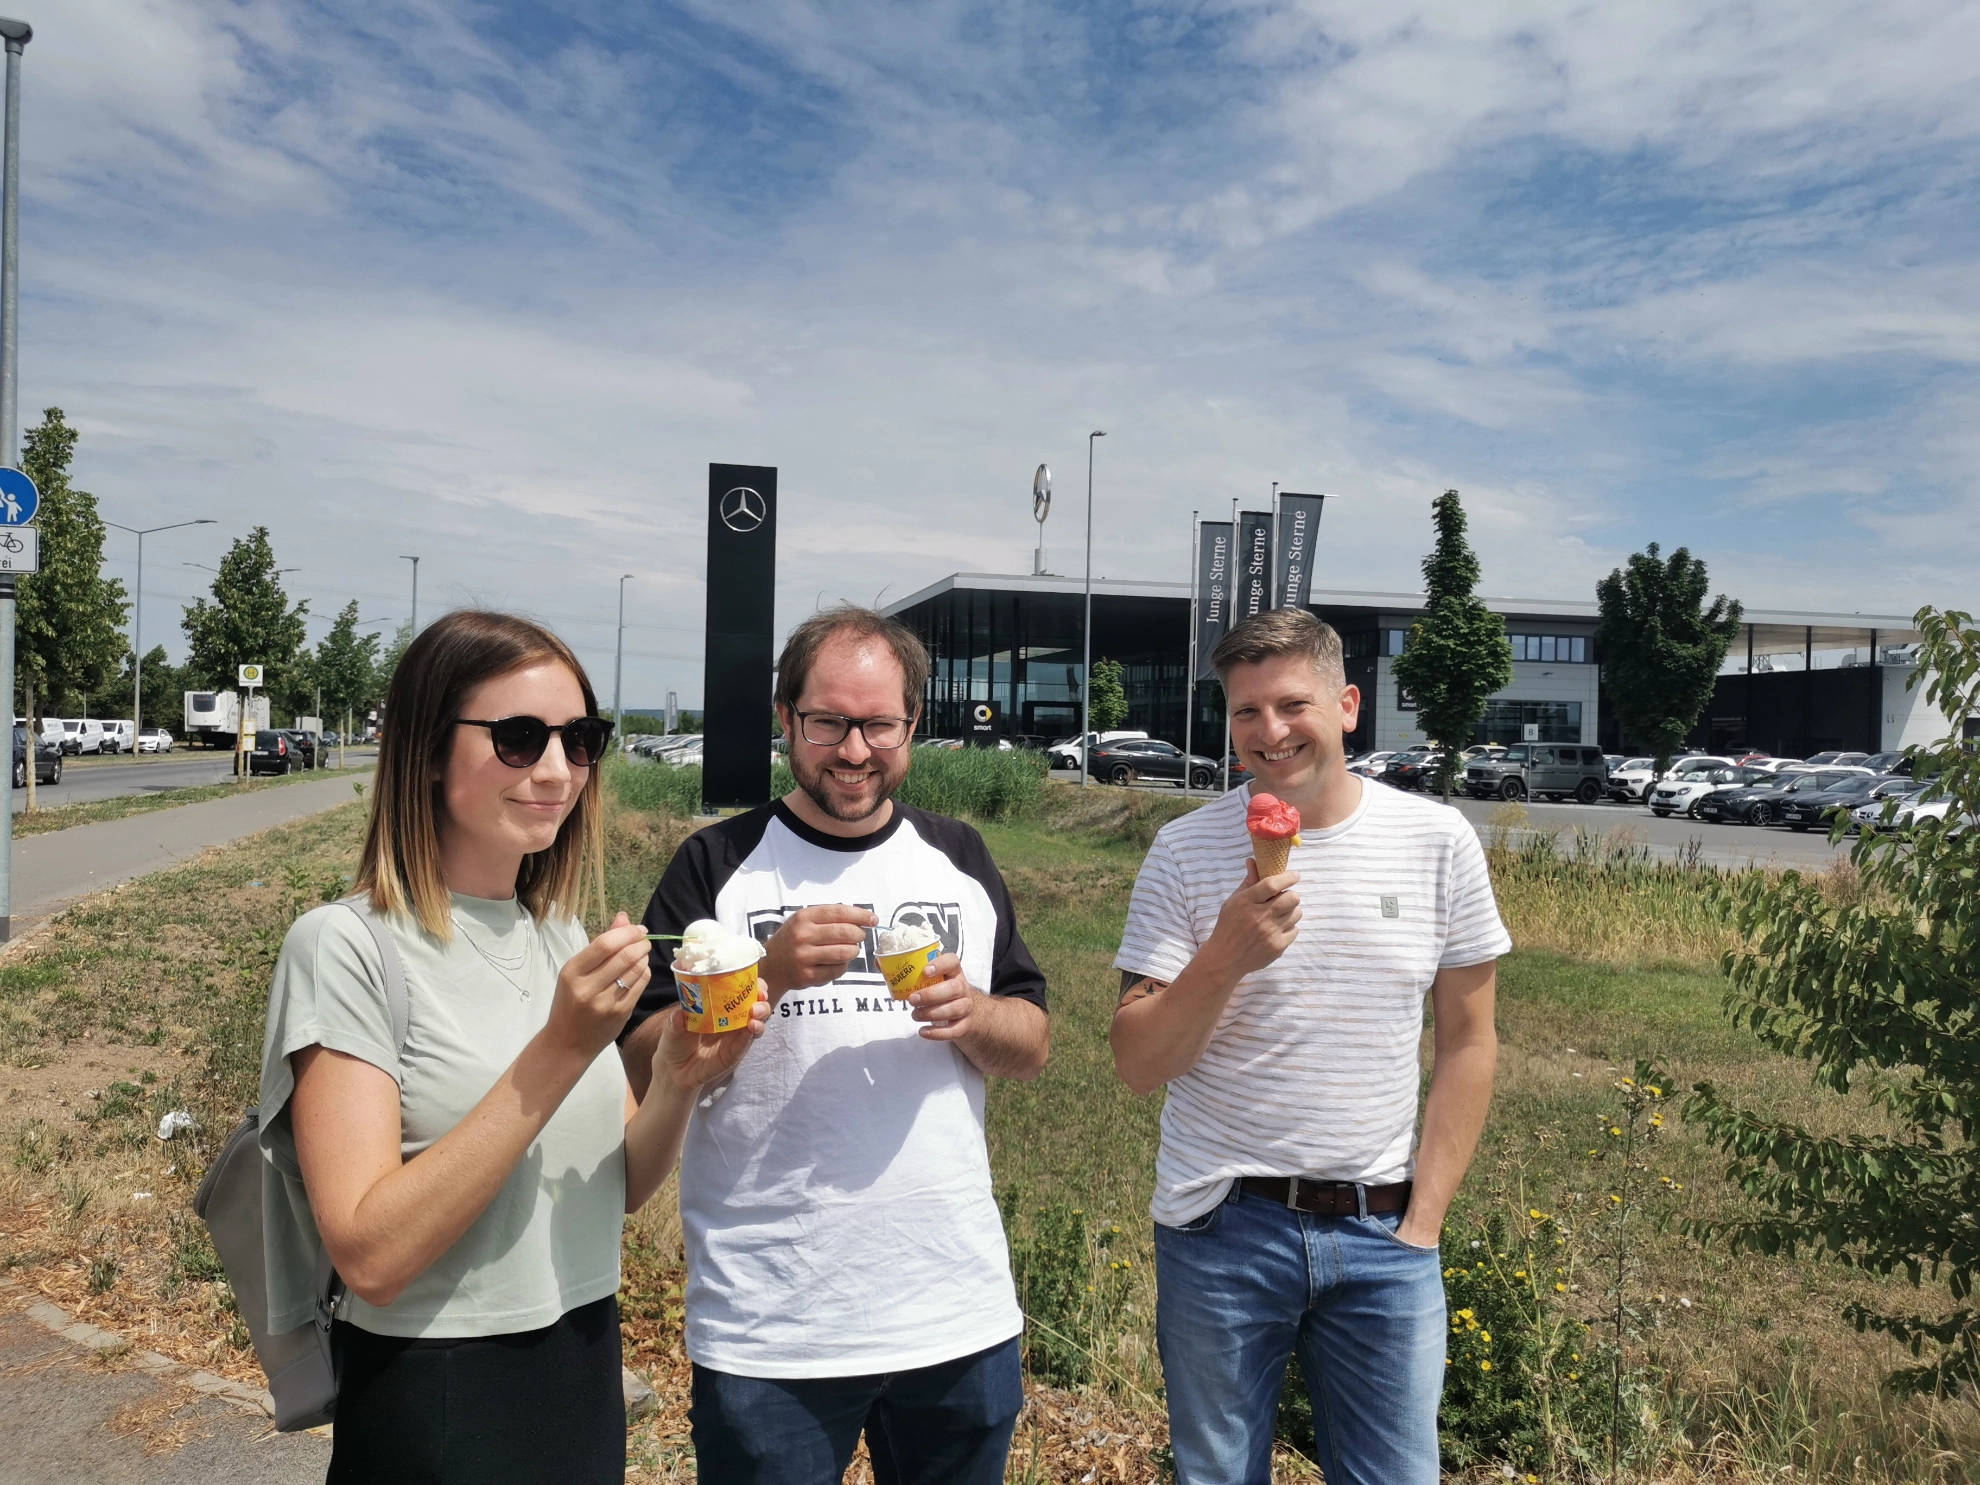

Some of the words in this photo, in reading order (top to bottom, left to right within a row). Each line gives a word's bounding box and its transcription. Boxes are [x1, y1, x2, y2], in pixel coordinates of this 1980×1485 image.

[1248, 528, 1266, 575] Sterne
[1288, 510, 1307, 561] Sterne
[1209, 536, 1227, 581] Sterne
[1206, 584, 1224, 624] Junge
[1247, 579, 1264, 617] unge
[1283, 565, 1302, 609] Junge
[247, 669, 255, 678] H
[1528, 728, 1534, 736] B
[890, 963, 916, 988] RIVIERA
[723, 980, 755, 1014] RIVIERA
[780, 998, 843, 1018] STILL
